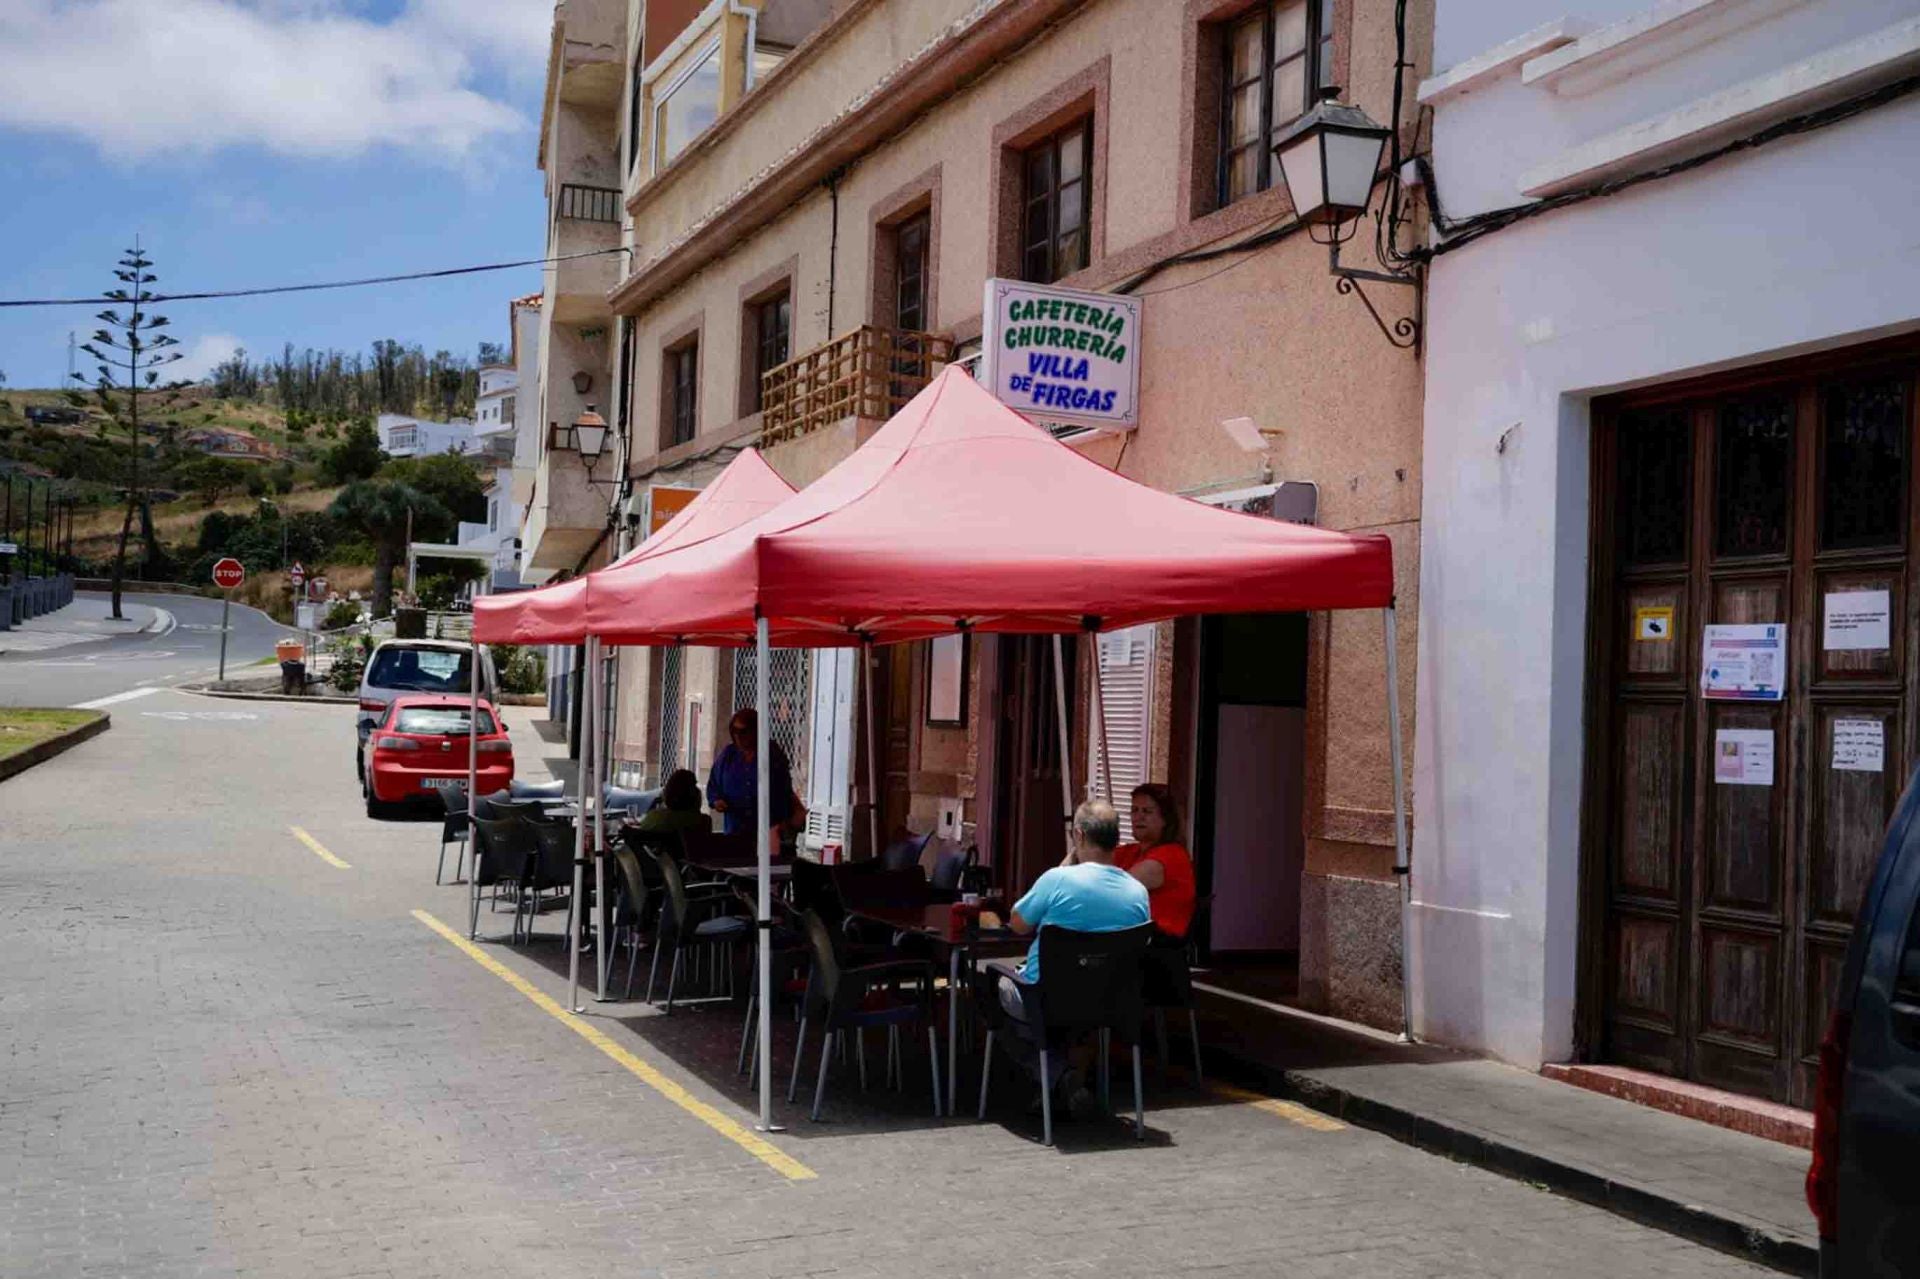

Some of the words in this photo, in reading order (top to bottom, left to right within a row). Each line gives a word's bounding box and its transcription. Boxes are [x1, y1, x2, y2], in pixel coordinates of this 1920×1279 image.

[1009, 300, 1125, 337] CAFETERÍA
[1005, 326, 1127, 364] CHURRERÍA
[1028, 352, 1089, 381] VILLA
[1009, 373, 1032, 393] DE
[1032, 382, 1117, 412] FIRGAS
[216, 569, 242, 578] STOP
